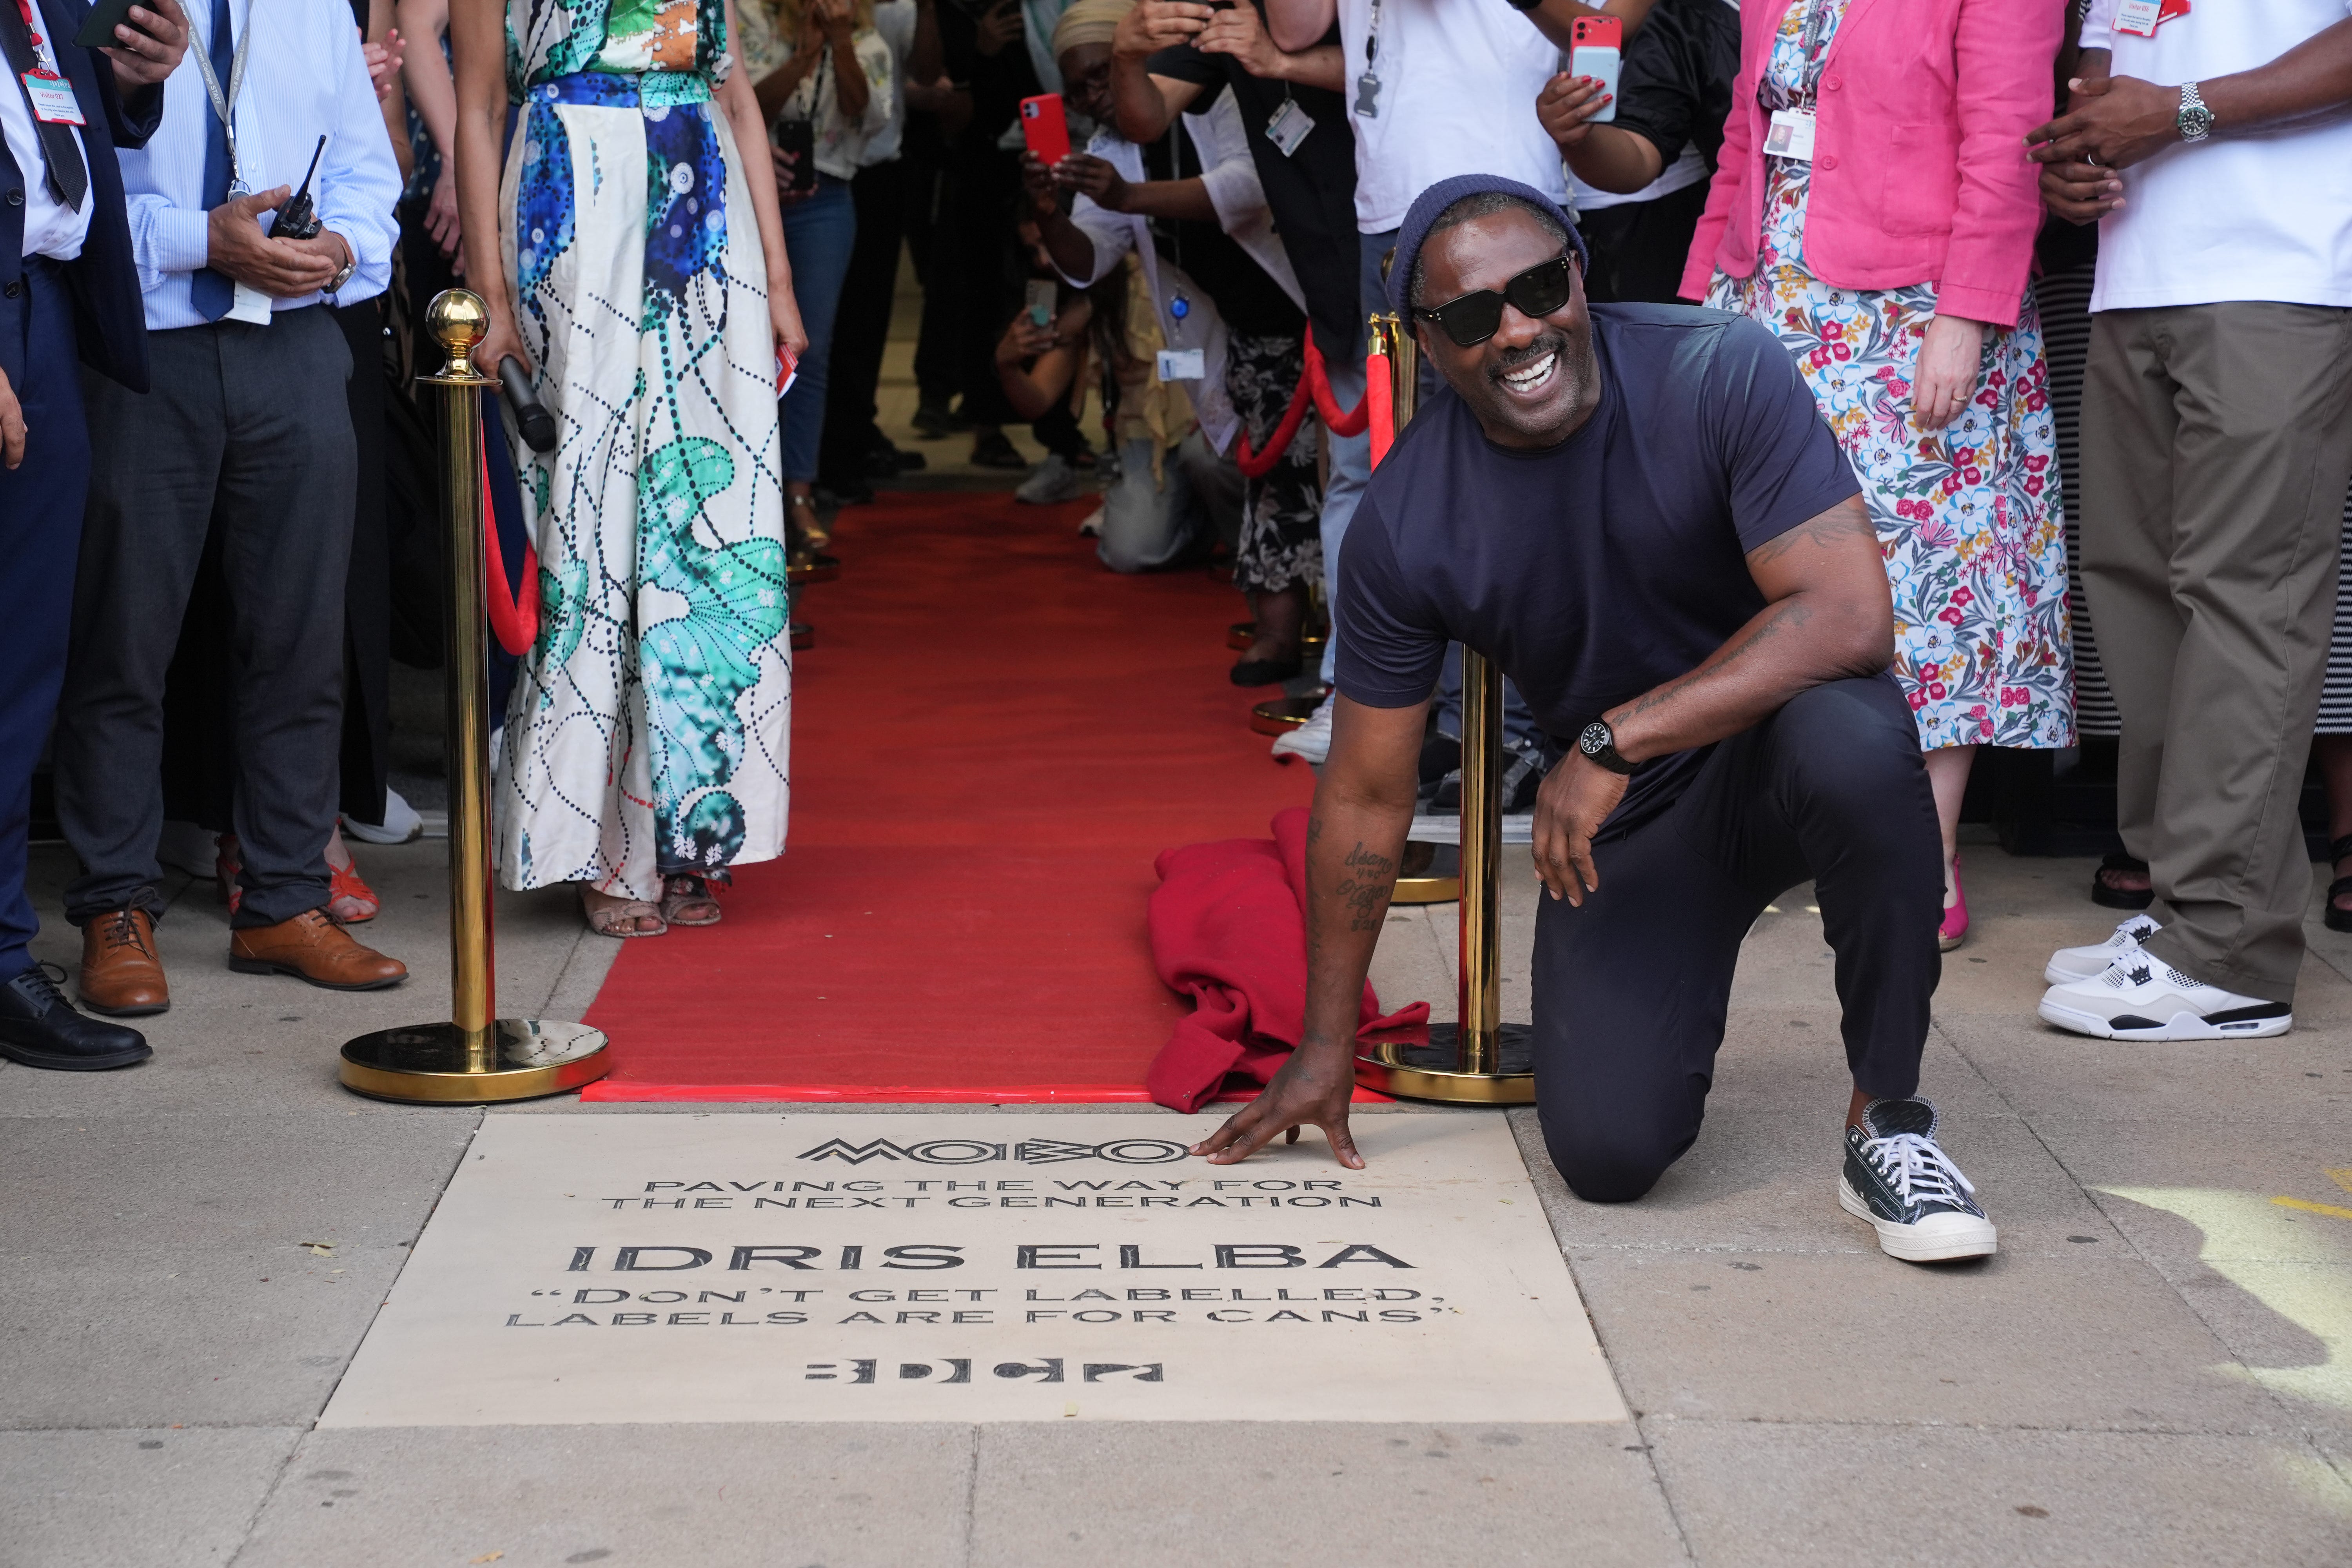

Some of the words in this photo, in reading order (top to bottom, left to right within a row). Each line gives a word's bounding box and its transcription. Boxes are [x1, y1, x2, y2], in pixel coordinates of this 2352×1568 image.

[2129, 2, 2141, 11] Visitor
[190, 31, 205, 62] Dagenham
[202, 62, 213, 85] College
[211, 85, 221, 104] STAFF
[234, 53, 244, 80] Dagenham
[795, 1138, 1190, 1165] MOBO
[644, 1181, 884, 1192] PAVING
[904, 1180, 1033, 1191] THE
[1053, 1180, 1192, 1191] WAY
[1212, 1180, 1344, 1191] FOR
[601, 1198, 733, 1209] THE
[754, 1197, 930, 1209] NEXT
[948, 1196, 1382, 1208] GENERATION
[564, 1244, 965, 1271] IDRIS
[1014, 1244, 1419, 1270] ELBA
[848, 1289, 998, 1302] GET
[1026, 1288, 1444, 1304] LABELLED,
[505, 1312, 808, 1327] LABELS
[838, 1311, 994, 1324] ARE
[1026, 1310, 1177, 1323] FOR
